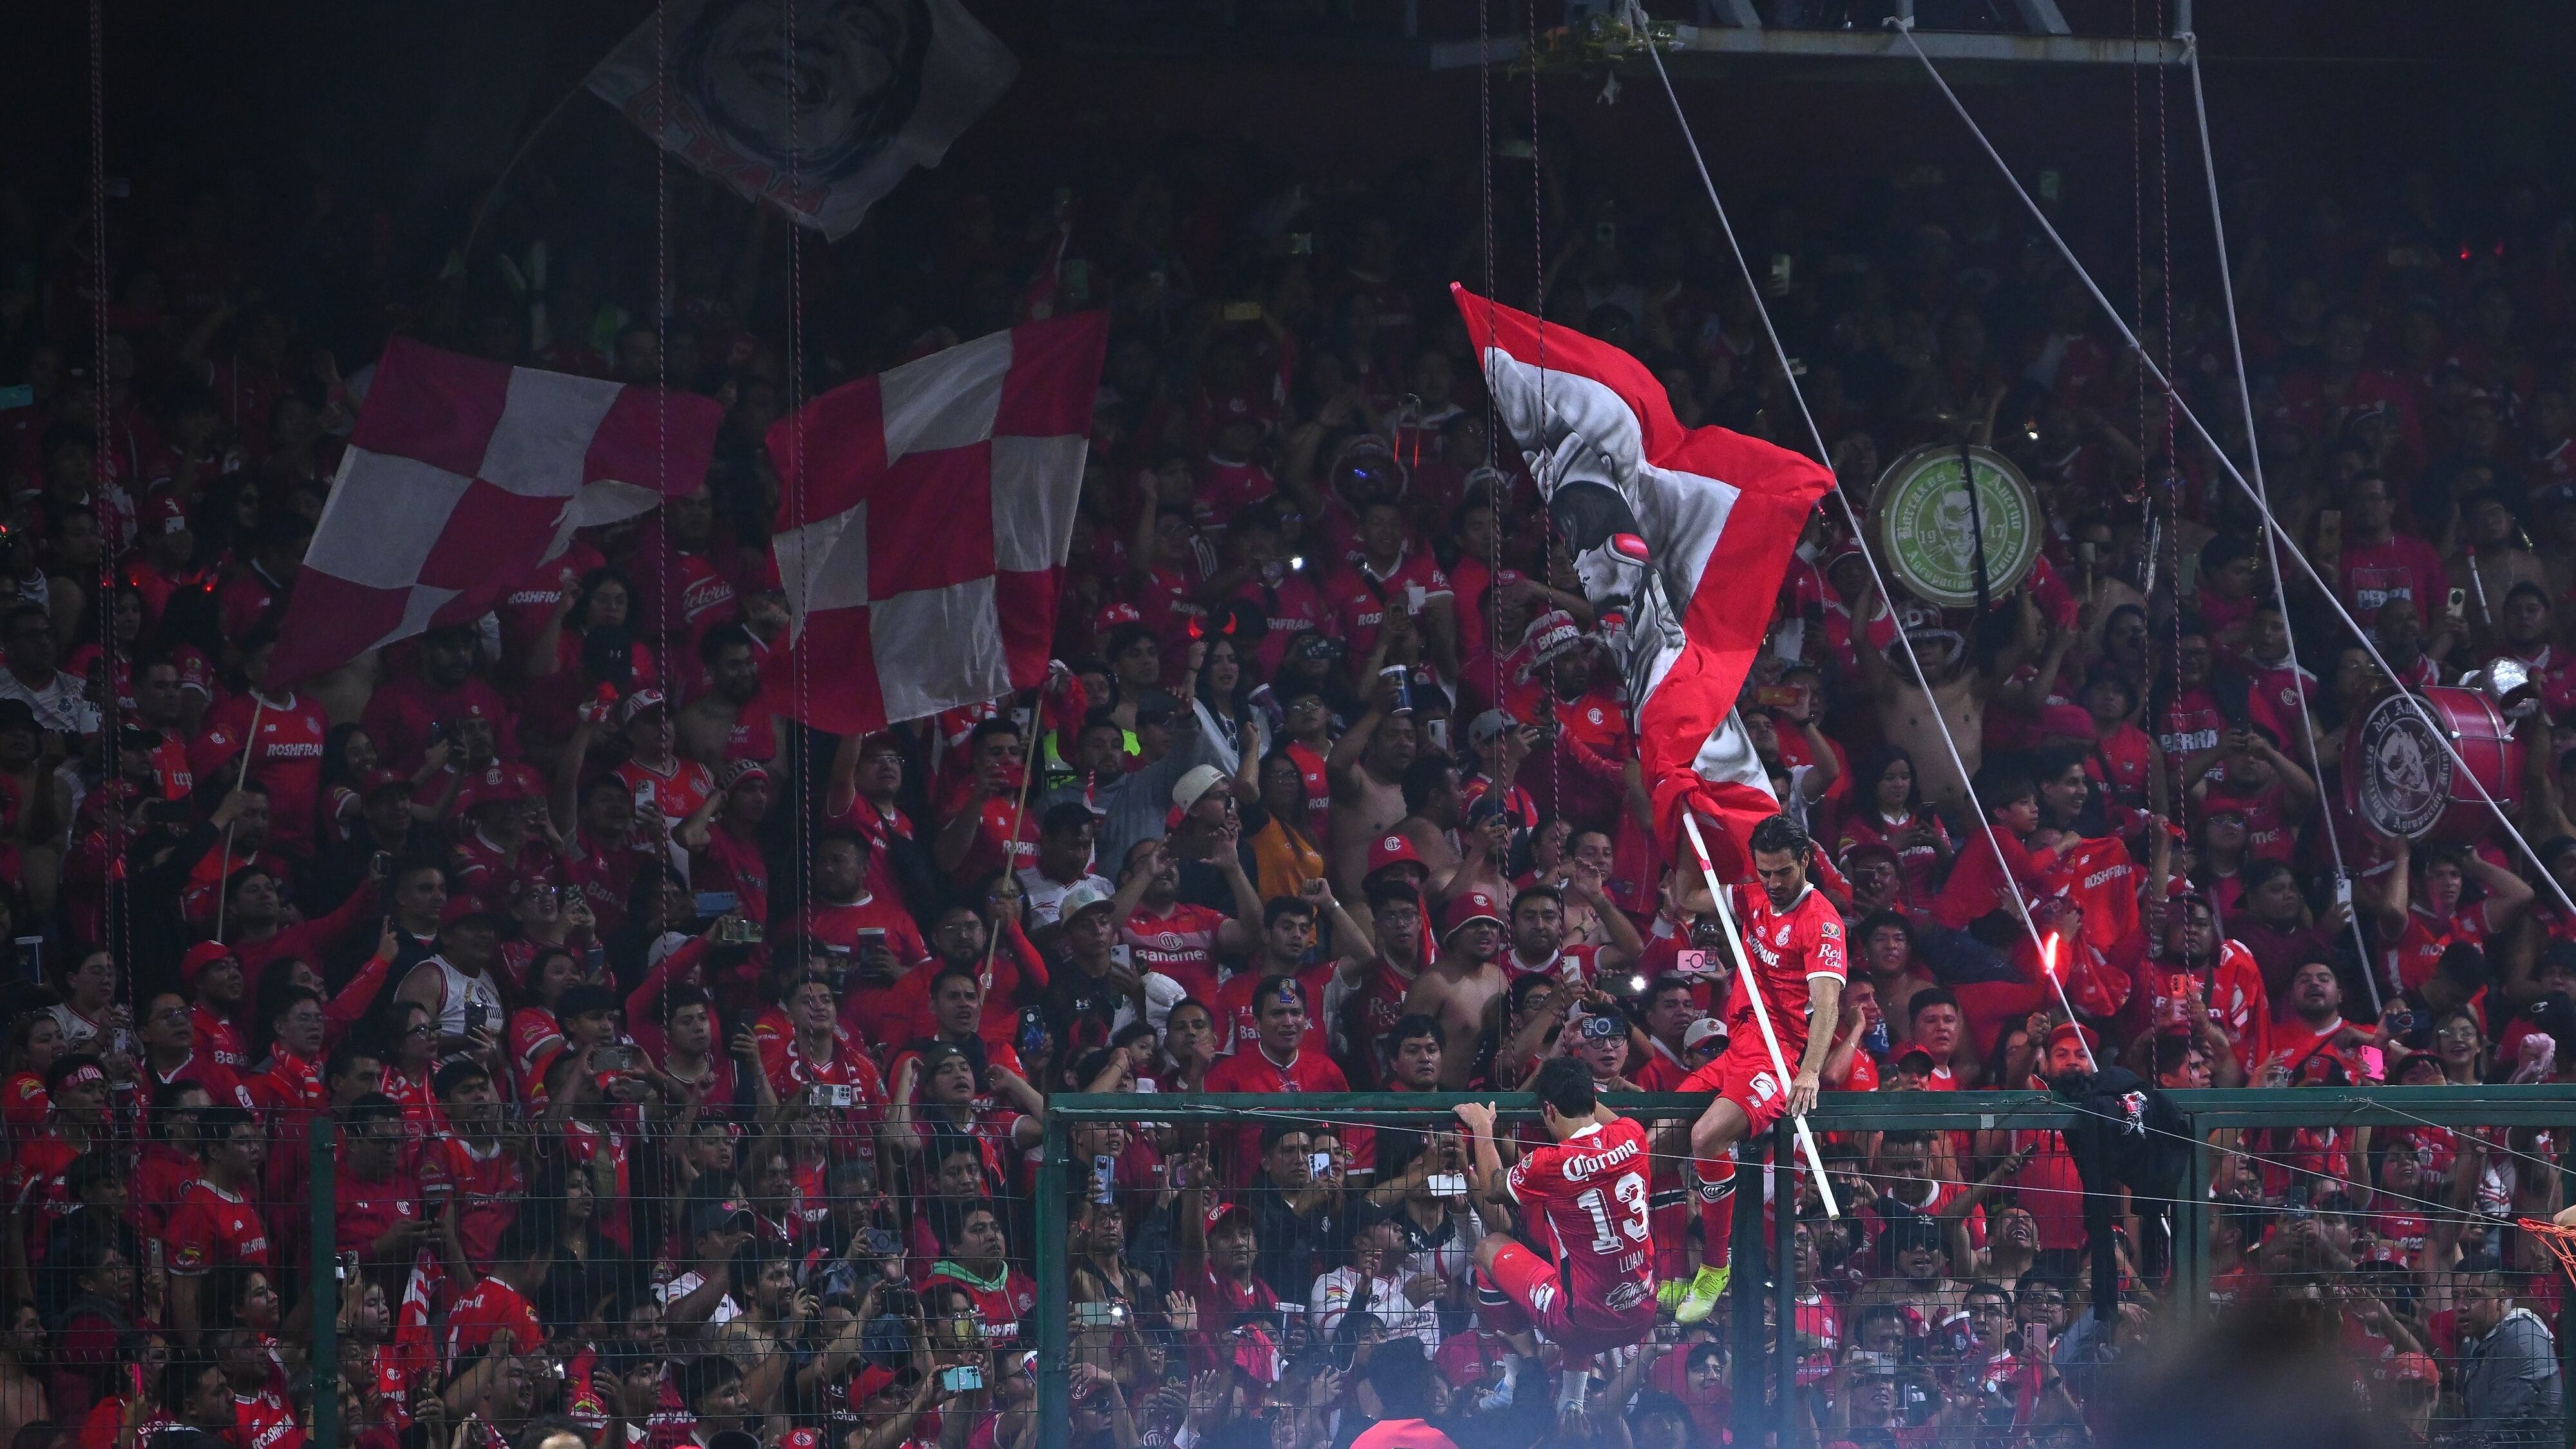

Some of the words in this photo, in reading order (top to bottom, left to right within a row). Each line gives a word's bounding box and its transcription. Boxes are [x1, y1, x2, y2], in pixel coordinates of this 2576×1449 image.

[1818, 943, 1843, 961] Red
[1824, 959, 1843, 969] Cola
[1562, 1139, 1640, 1182] Corona
[1576, 1171, 1650, 1256] 13
[1618, 1249, 1644, 1274] LUAN
